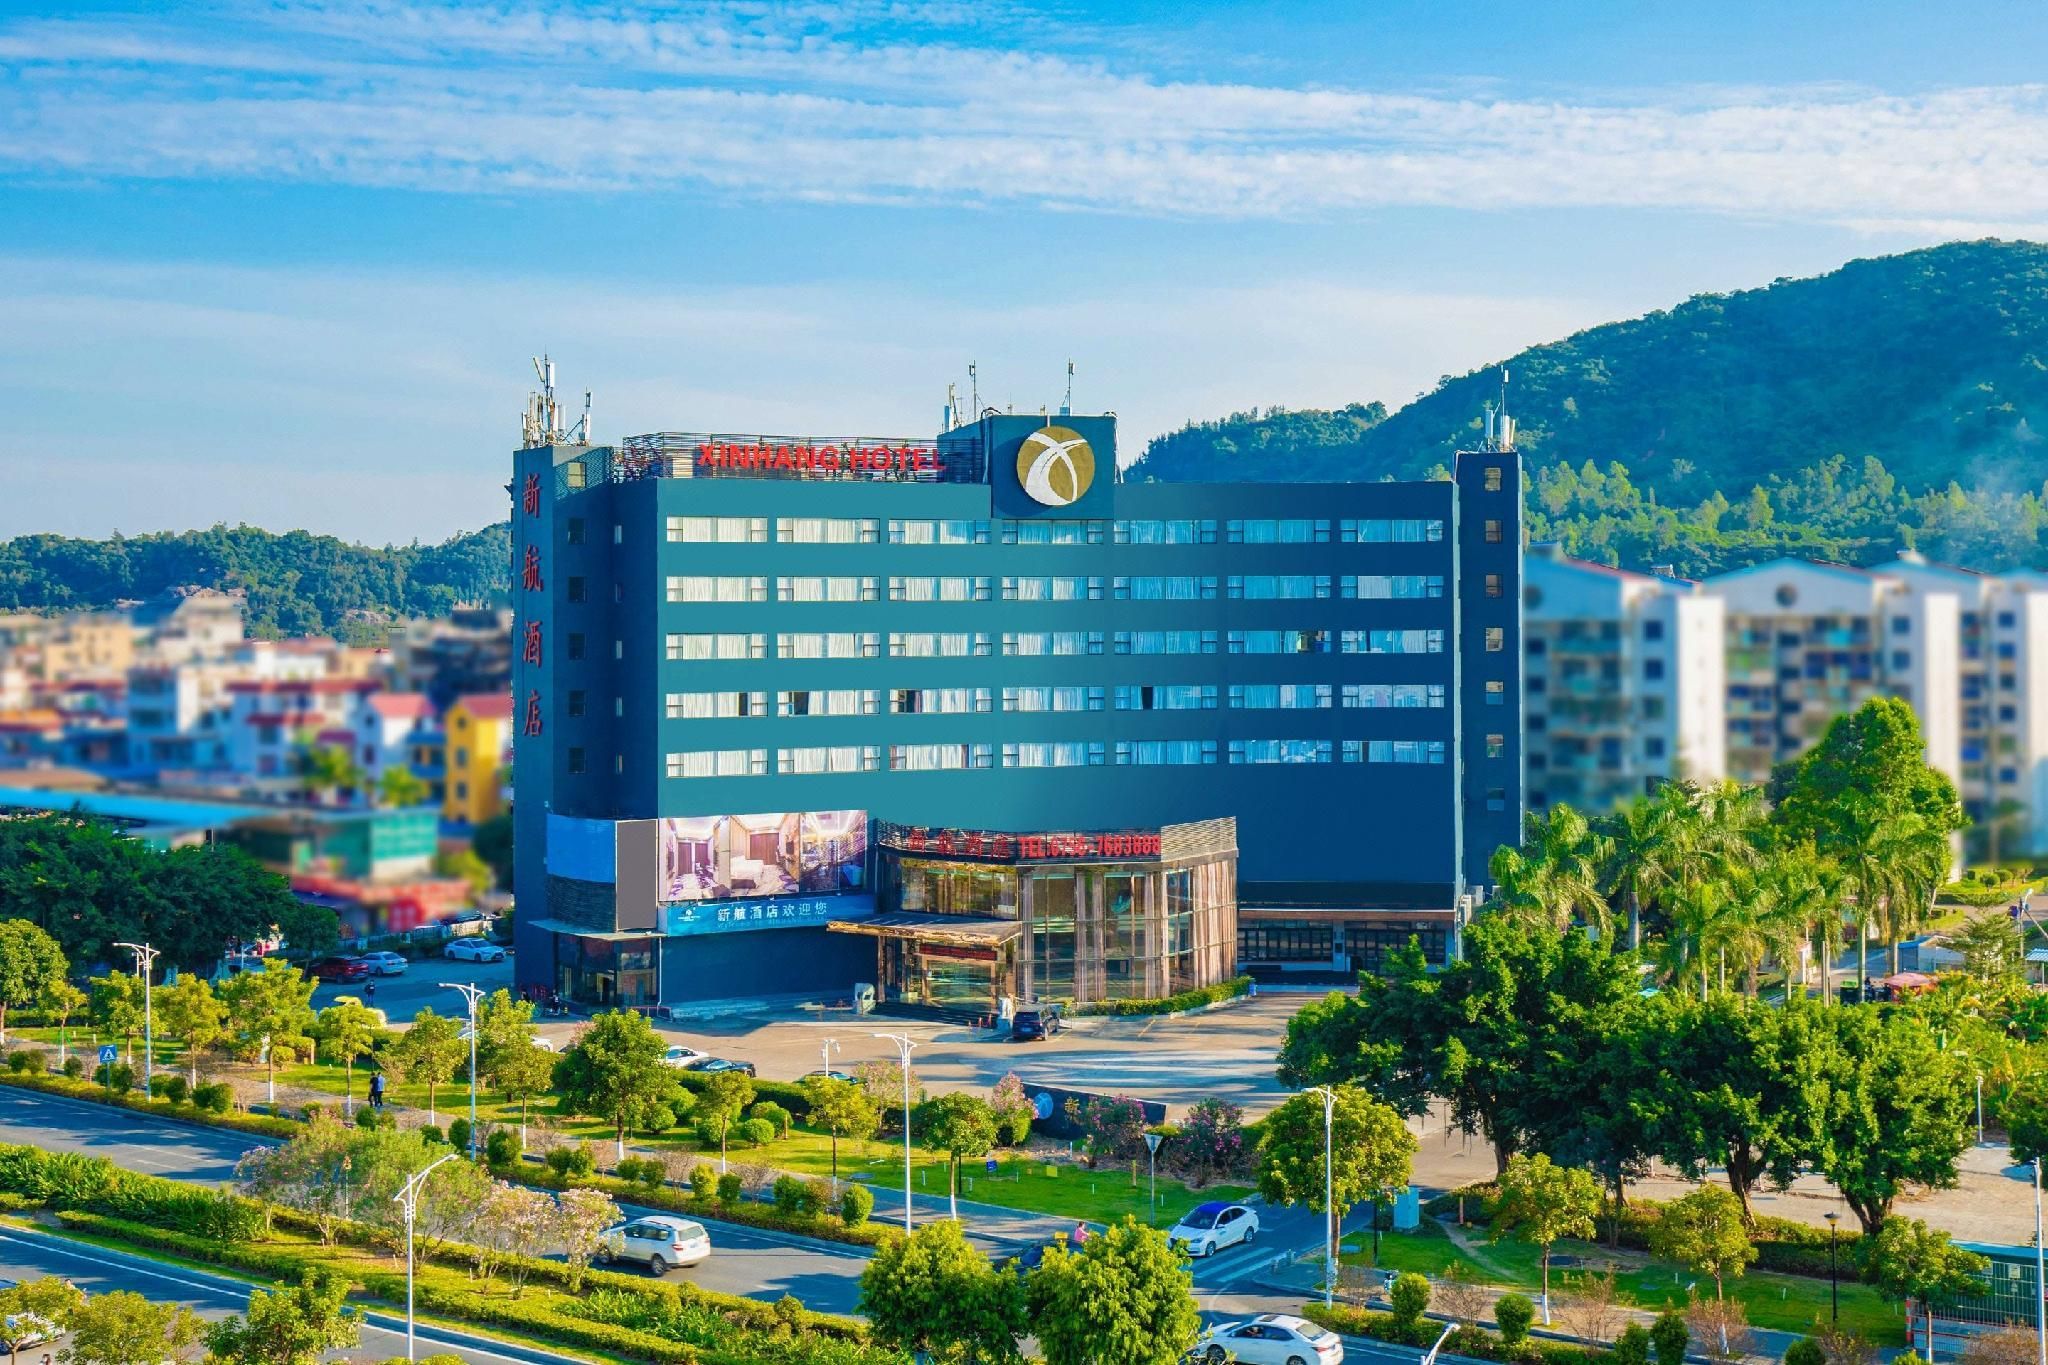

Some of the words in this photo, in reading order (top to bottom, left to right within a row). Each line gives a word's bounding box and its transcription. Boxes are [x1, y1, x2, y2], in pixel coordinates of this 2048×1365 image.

[697, 443, 839, 471] XINHANG
[850, 445, 946, 471] HOTEL
[522, 473, 544, 737] 新航酒店
[717, 901, 828, 922] 新航酒店欢迎您
